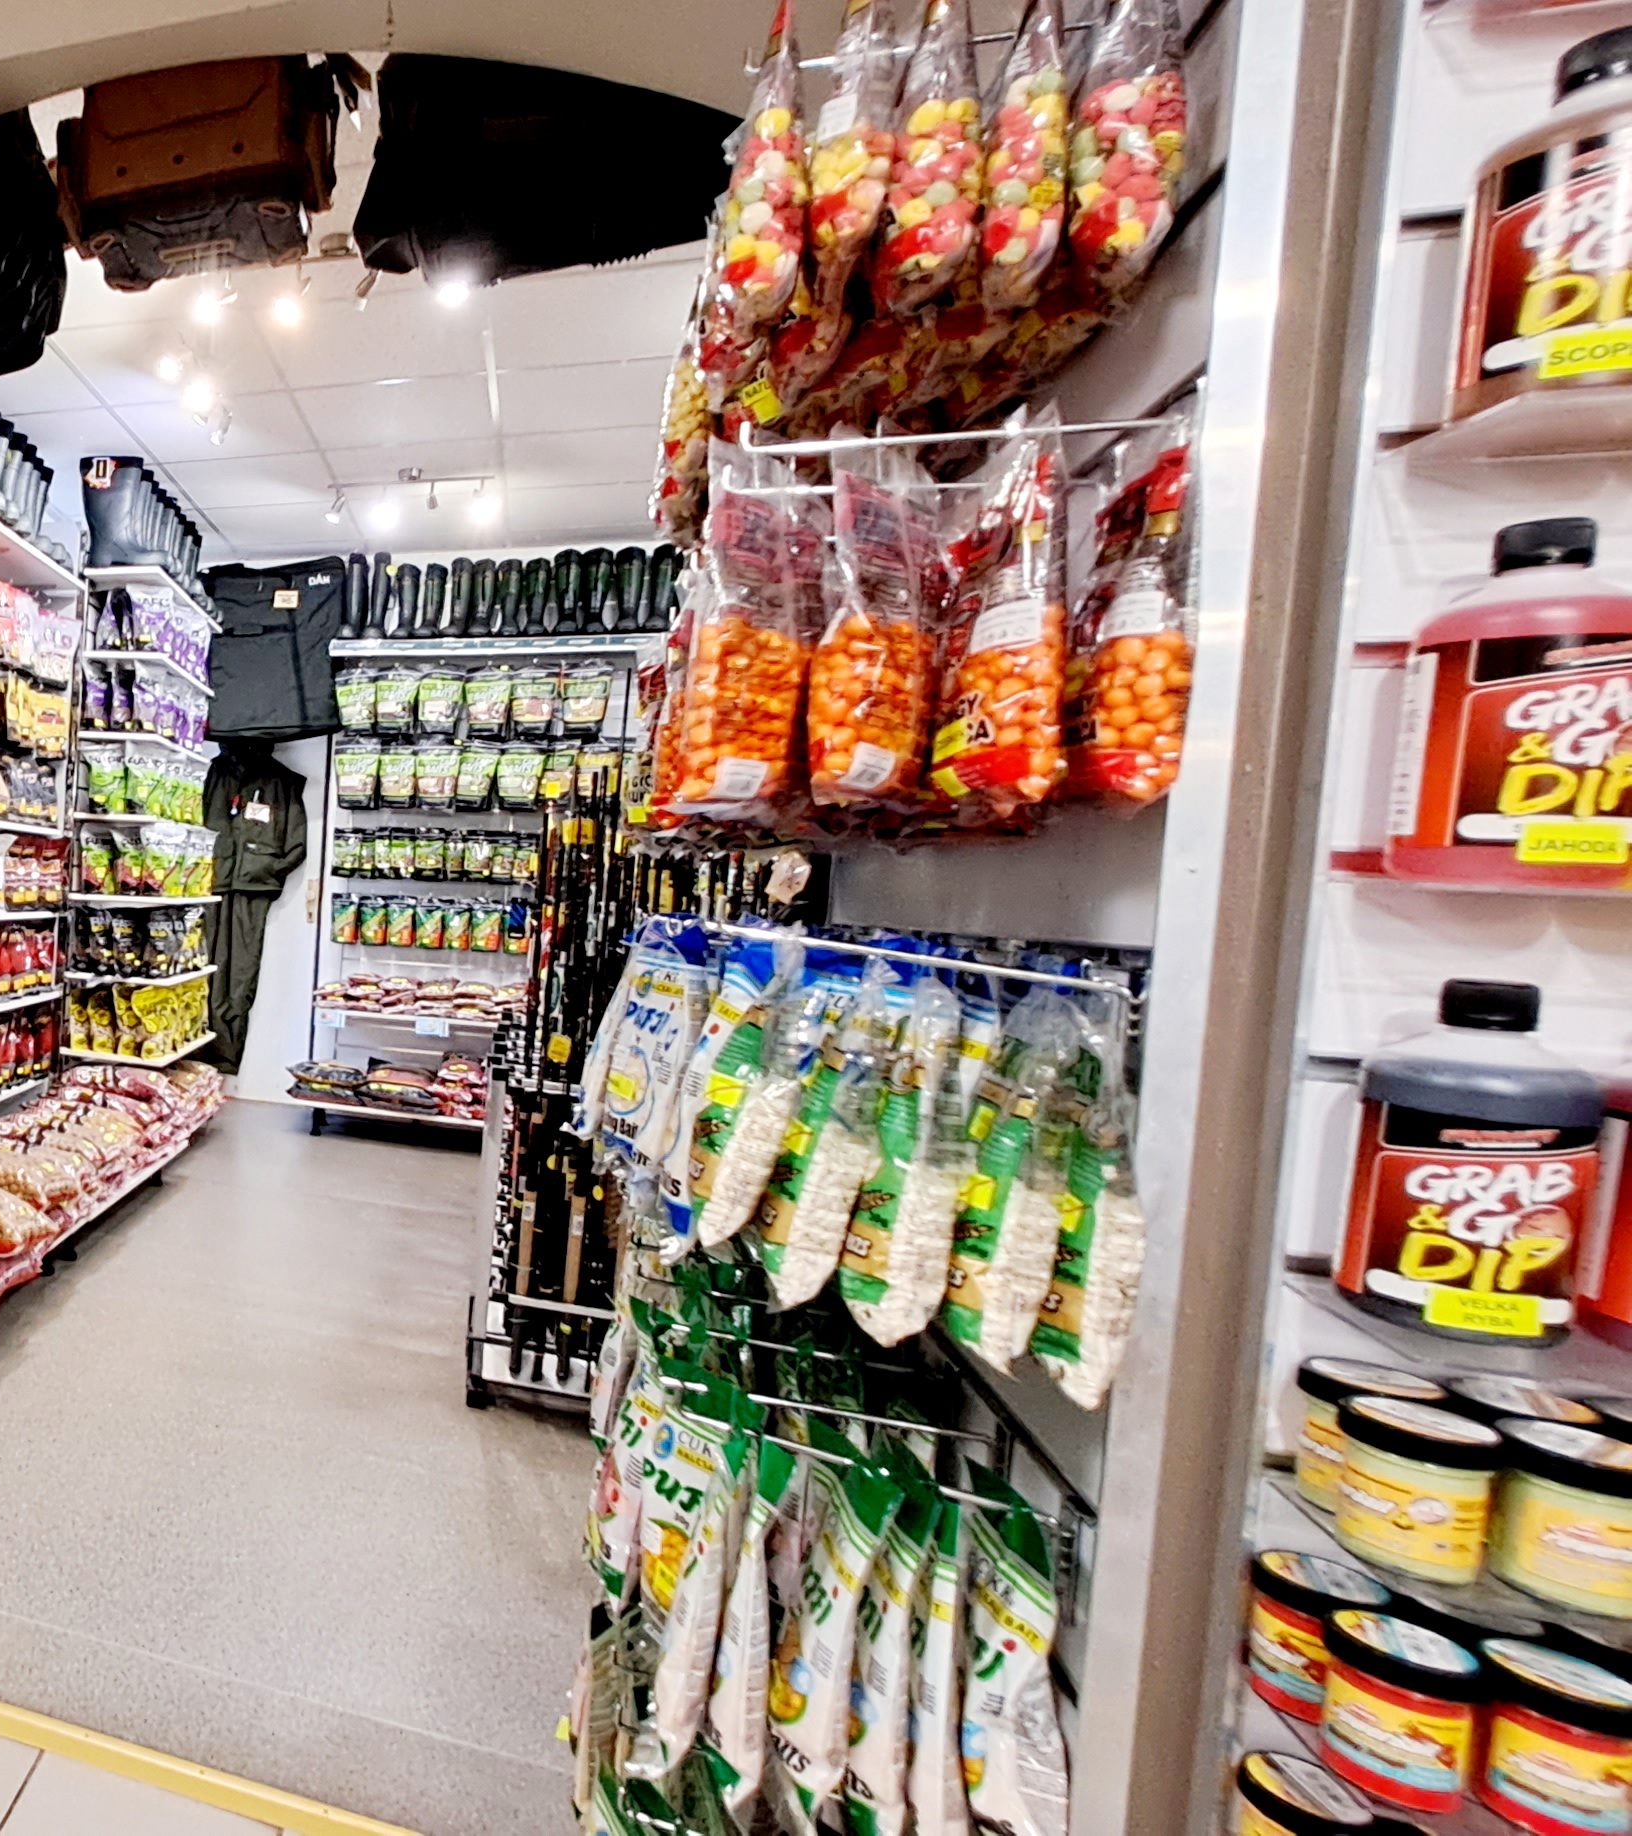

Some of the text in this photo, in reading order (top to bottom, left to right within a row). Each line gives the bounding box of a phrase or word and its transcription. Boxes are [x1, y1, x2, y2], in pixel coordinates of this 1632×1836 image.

[1517, 268, 1632, 339] DI
[1505, 677, 1632, 730] GRA
[1527, 838, 1617, 855] JAHODA
[1404, 1162, 1576, 1204] GRAB
[1407, 1203, 1449, 1231] &
[1398, 1231, 1567, 1292] DIP
